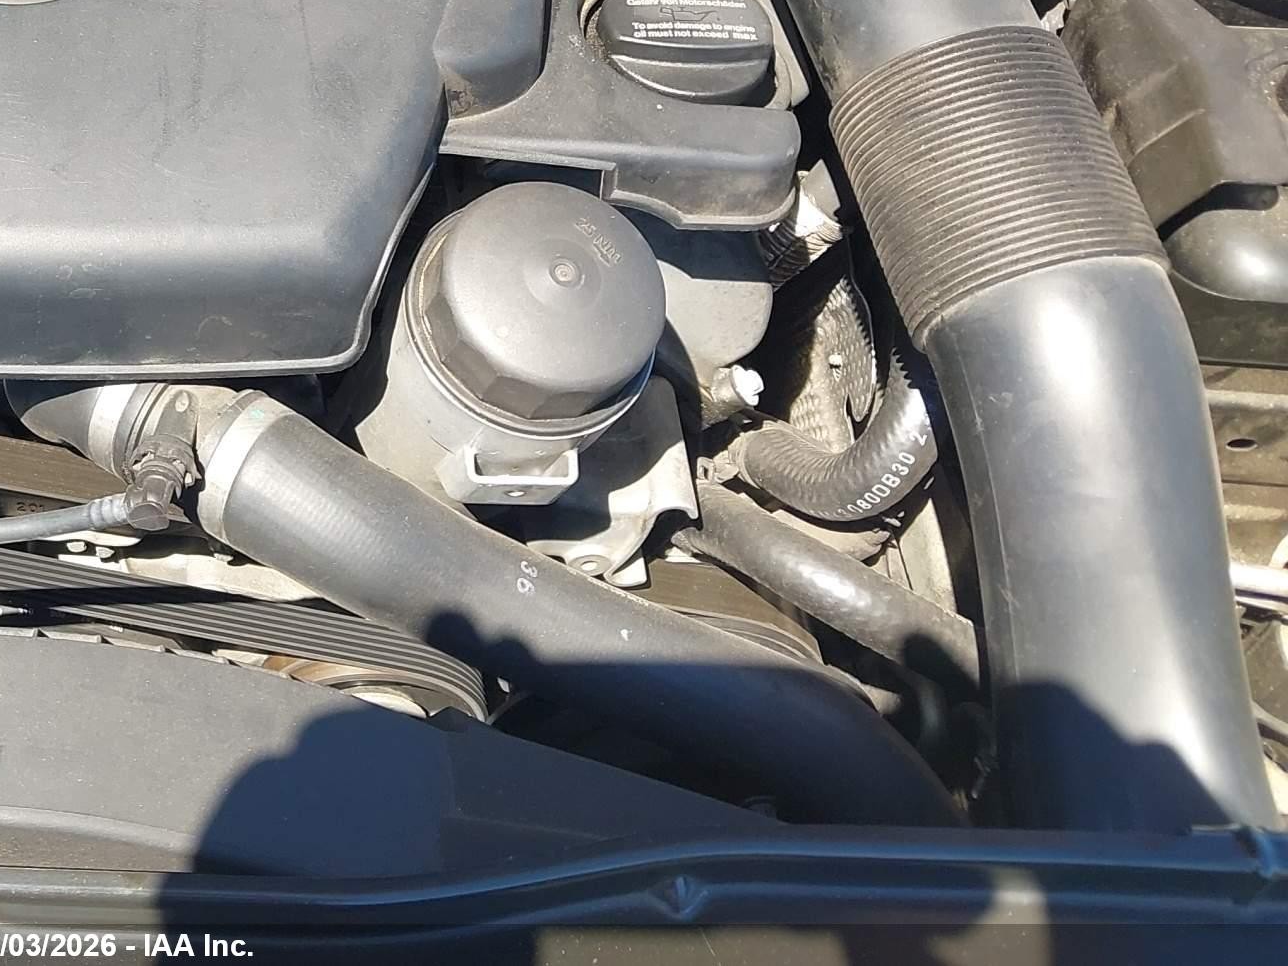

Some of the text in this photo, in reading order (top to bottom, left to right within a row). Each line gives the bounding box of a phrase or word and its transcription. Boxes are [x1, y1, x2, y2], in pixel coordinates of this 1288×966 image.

[632, 22, 646, 30] To
[646, 21, 673, 30] avoid
[674, 22, 712, 31] damage
[723, 24, 756, 33] engine
[633, 30, 647, 38] oil
[647, 30, 673, 38] must
[692, 30, 730, 39] exceed
